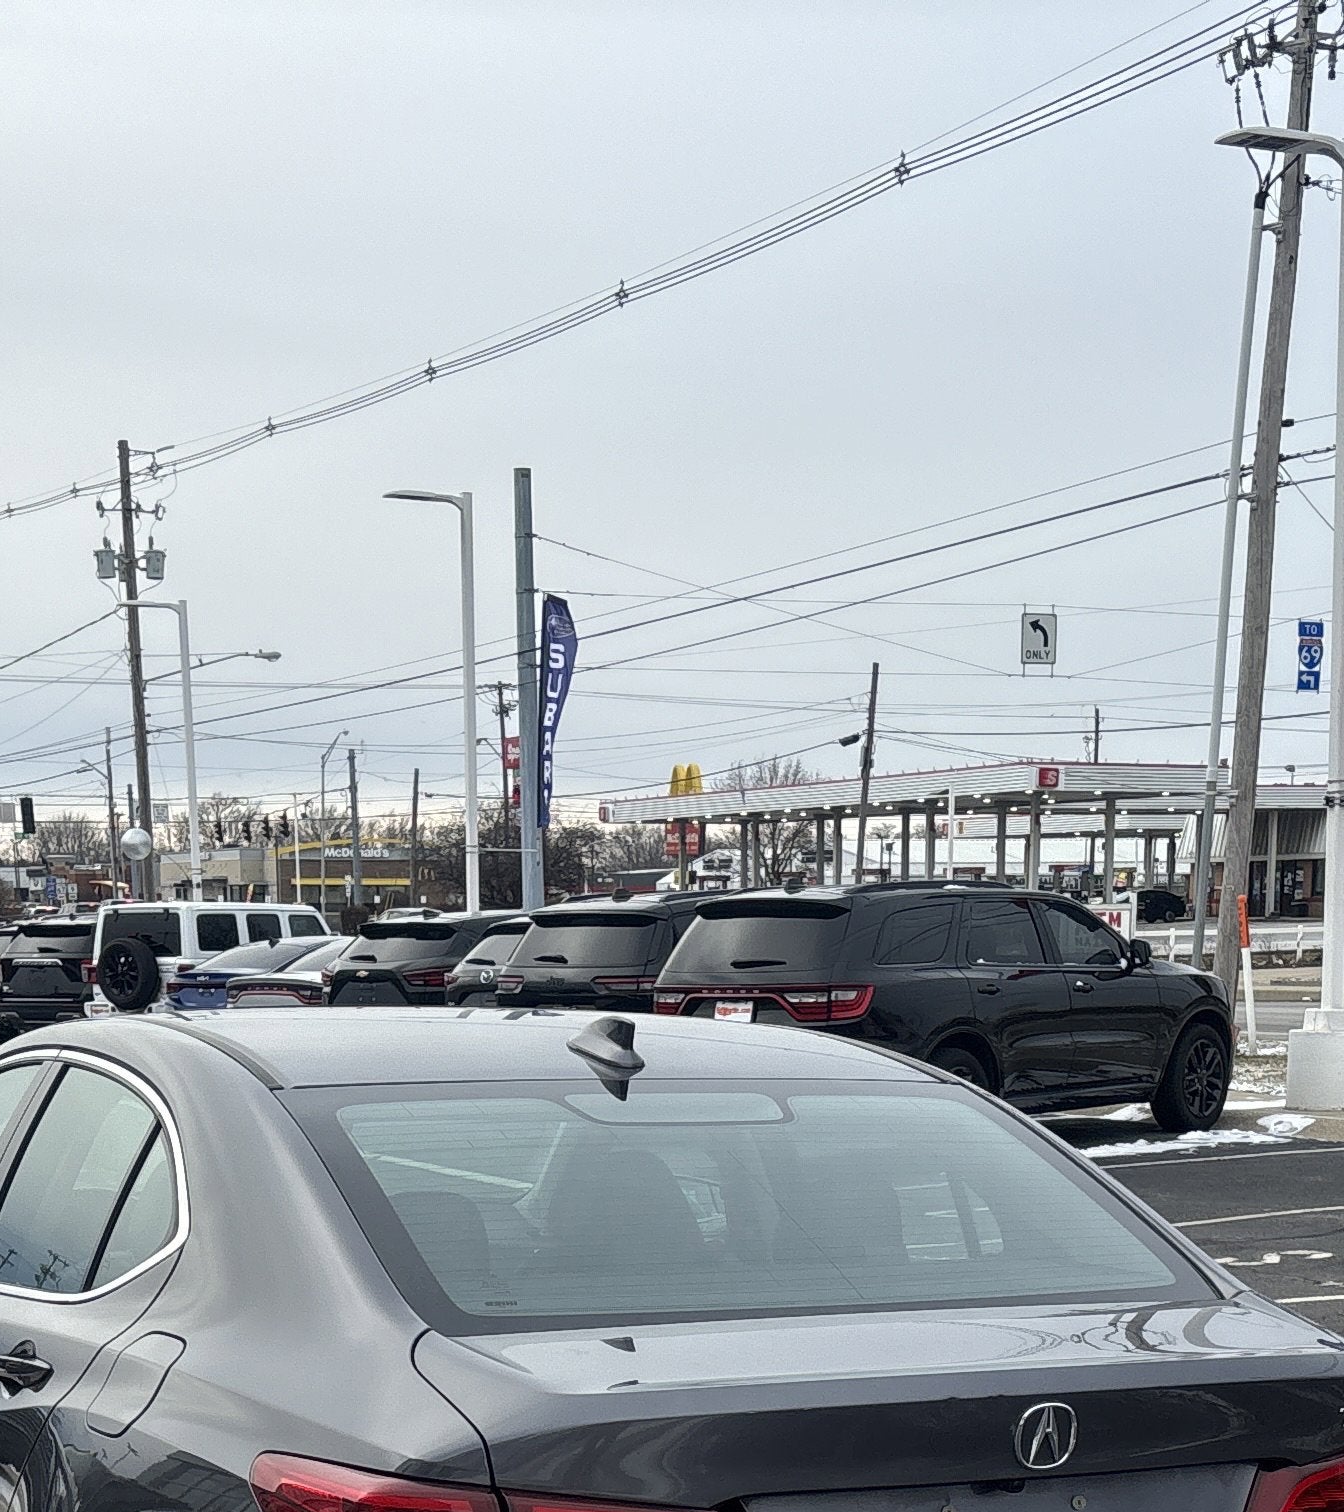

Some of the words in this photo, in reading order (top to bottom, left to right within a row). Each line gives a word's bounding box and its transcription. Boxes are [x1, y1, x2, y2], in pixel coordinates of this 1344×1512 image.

[1304, 625, 1318, 634] TO
[1026, 650, 1050, 660] ONLY
[1301, 646, 1321, 663] 69
